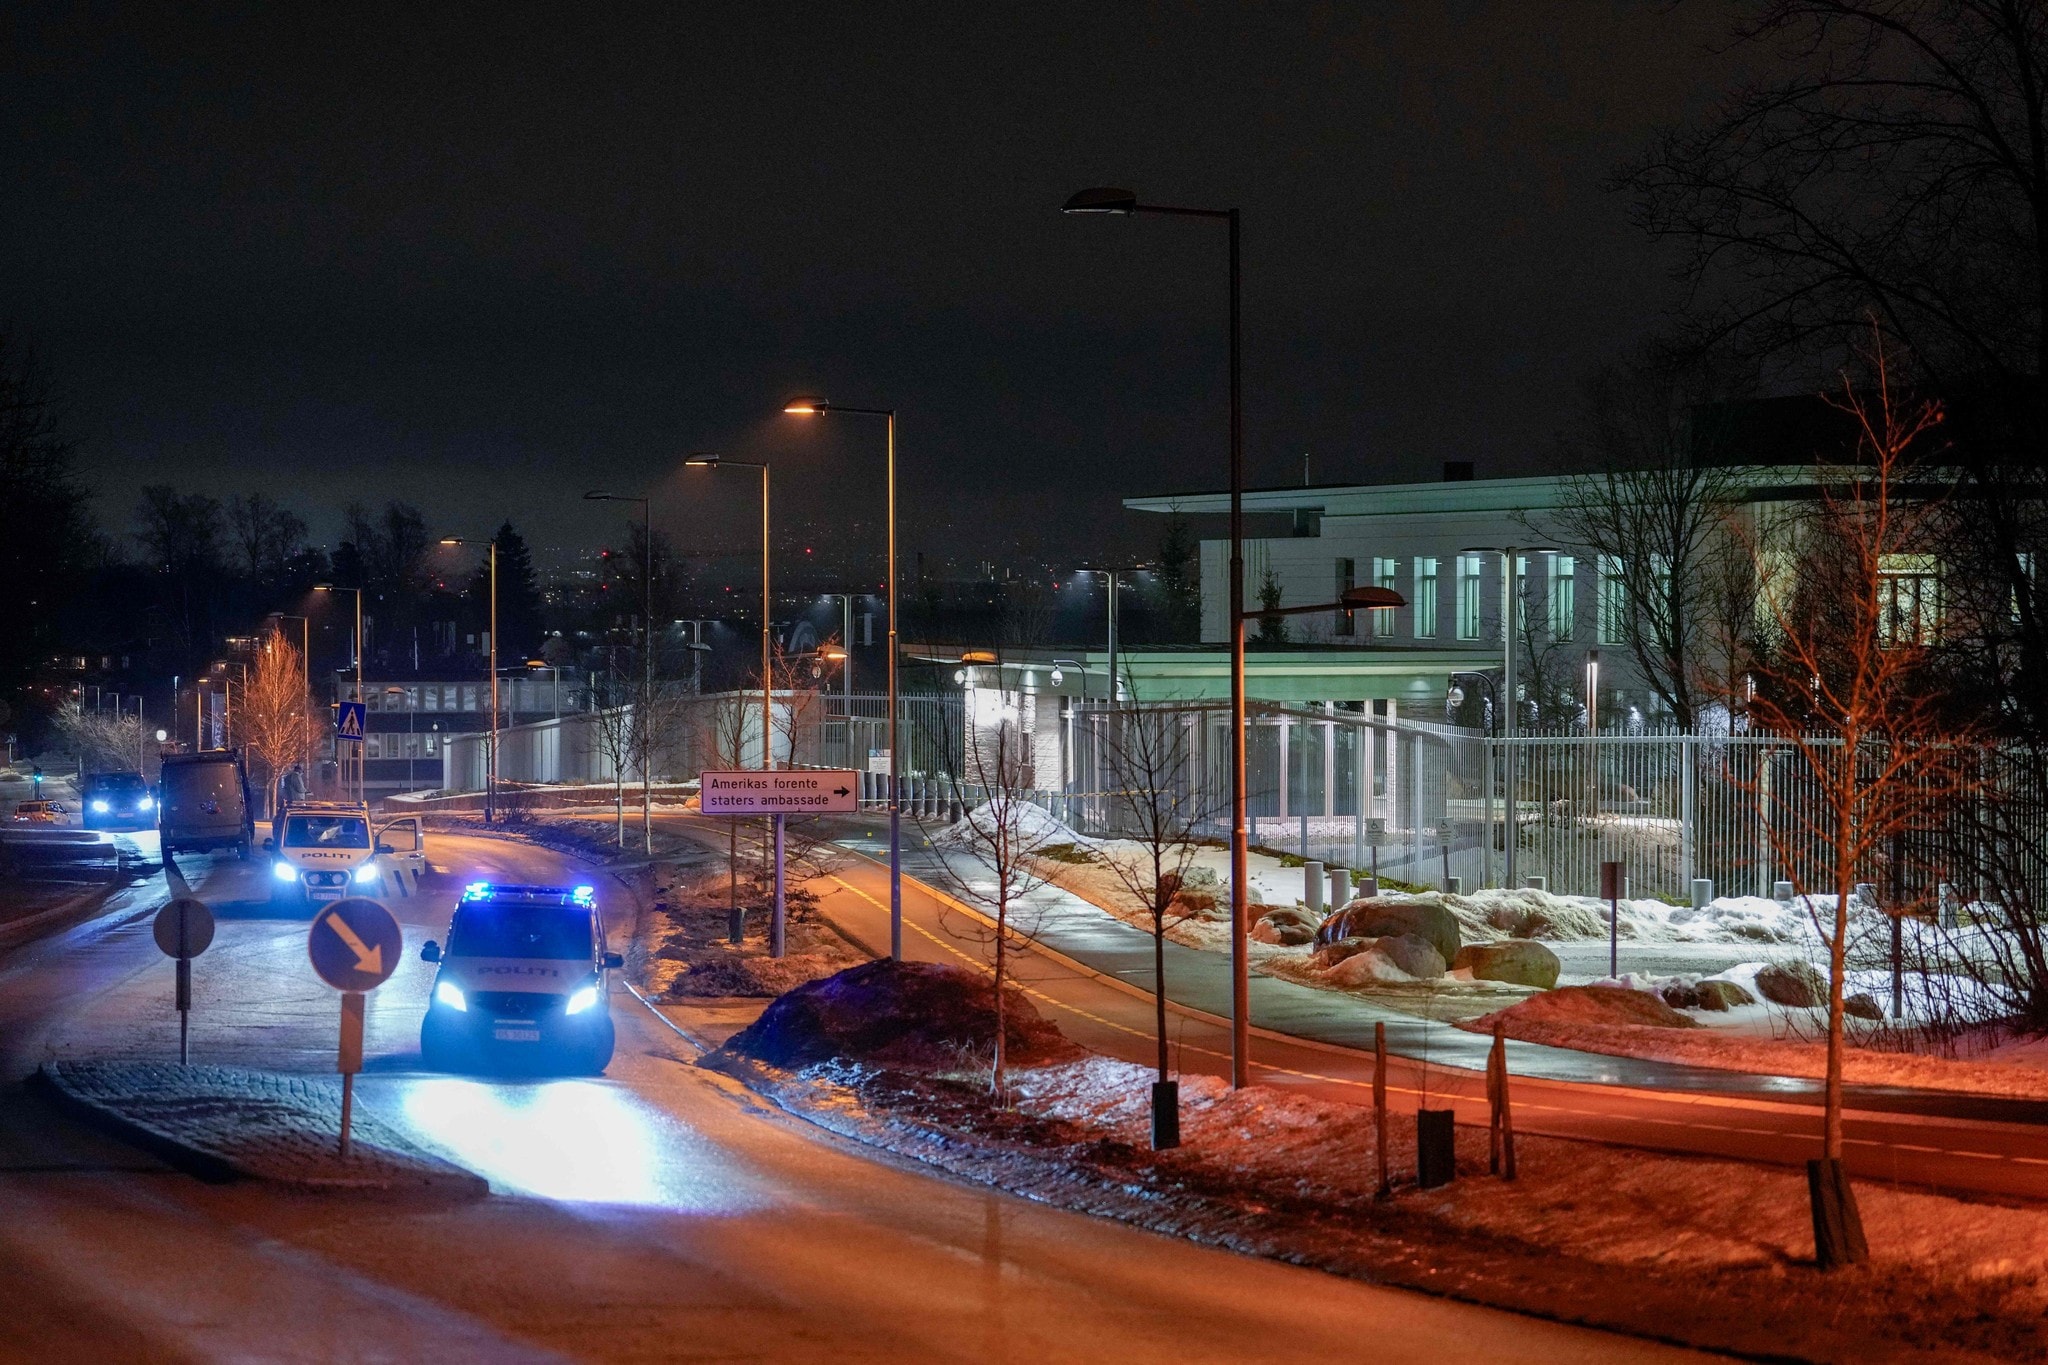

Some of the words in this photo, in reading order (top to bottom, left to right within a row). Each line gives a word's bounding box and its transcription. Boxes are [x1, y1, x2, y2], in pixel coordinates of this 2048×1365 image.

[711, 778, 768, 789] Amerikas
[774, 778, 818, 789] forente
[711, 795, 754, 806] staters
[761, 794, 829, 805] ambassade
[301, 852, 351, 860] POLITI
[478, 966, 559, 978] POLITI
